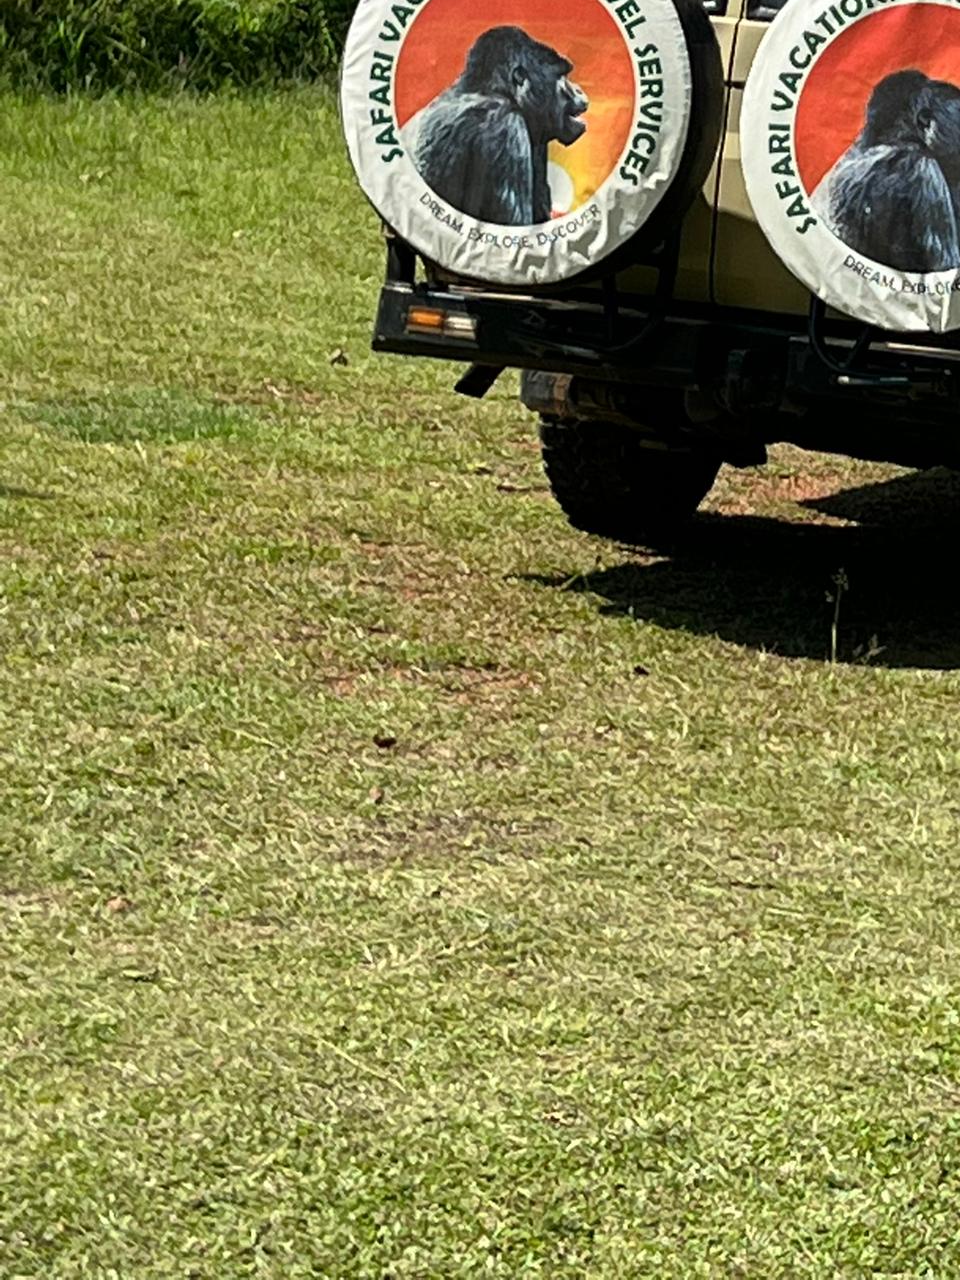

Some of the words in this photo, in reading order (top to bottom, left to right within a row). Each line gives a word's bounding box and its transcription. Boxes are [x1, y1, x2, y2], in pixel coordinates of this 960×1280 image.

[369, 51, 404, 164] SAFARI
[619, 42, 664, 186] SERVICES
[768, 122, 817, 234] SAFARI
